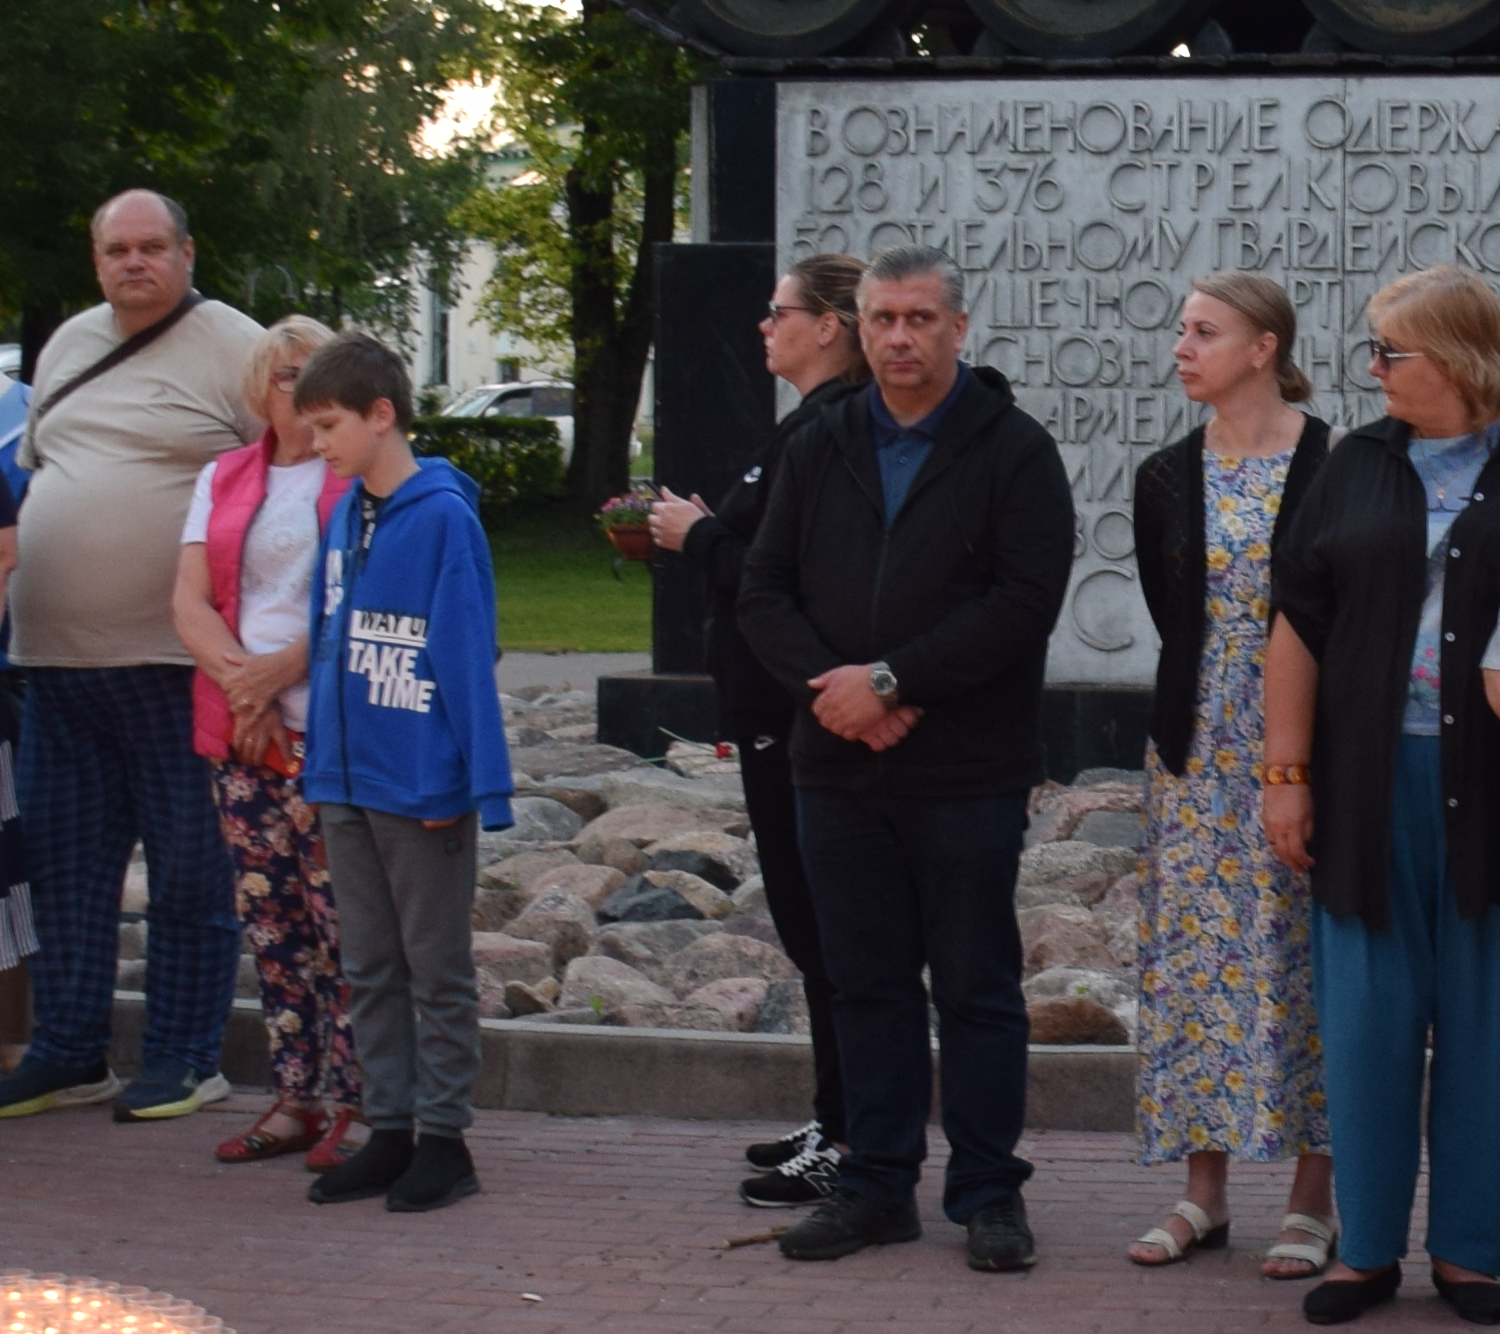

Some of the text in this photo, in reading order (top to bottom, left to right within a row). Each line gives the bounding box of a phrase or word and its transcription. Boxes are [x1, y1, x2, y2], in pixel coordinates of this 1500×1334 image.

[804, 107, 832, 157] В
[841, 97, 1280, 157] ОЗНАМЕНОВАНИЕ
[804, 163, 888, 214] 128
[914, 161, 946, 213] И
[975, 157, 1065, 213] 376
[348, 640, 419, 681] TAKE
[367, 672, 437, 714] TIME
